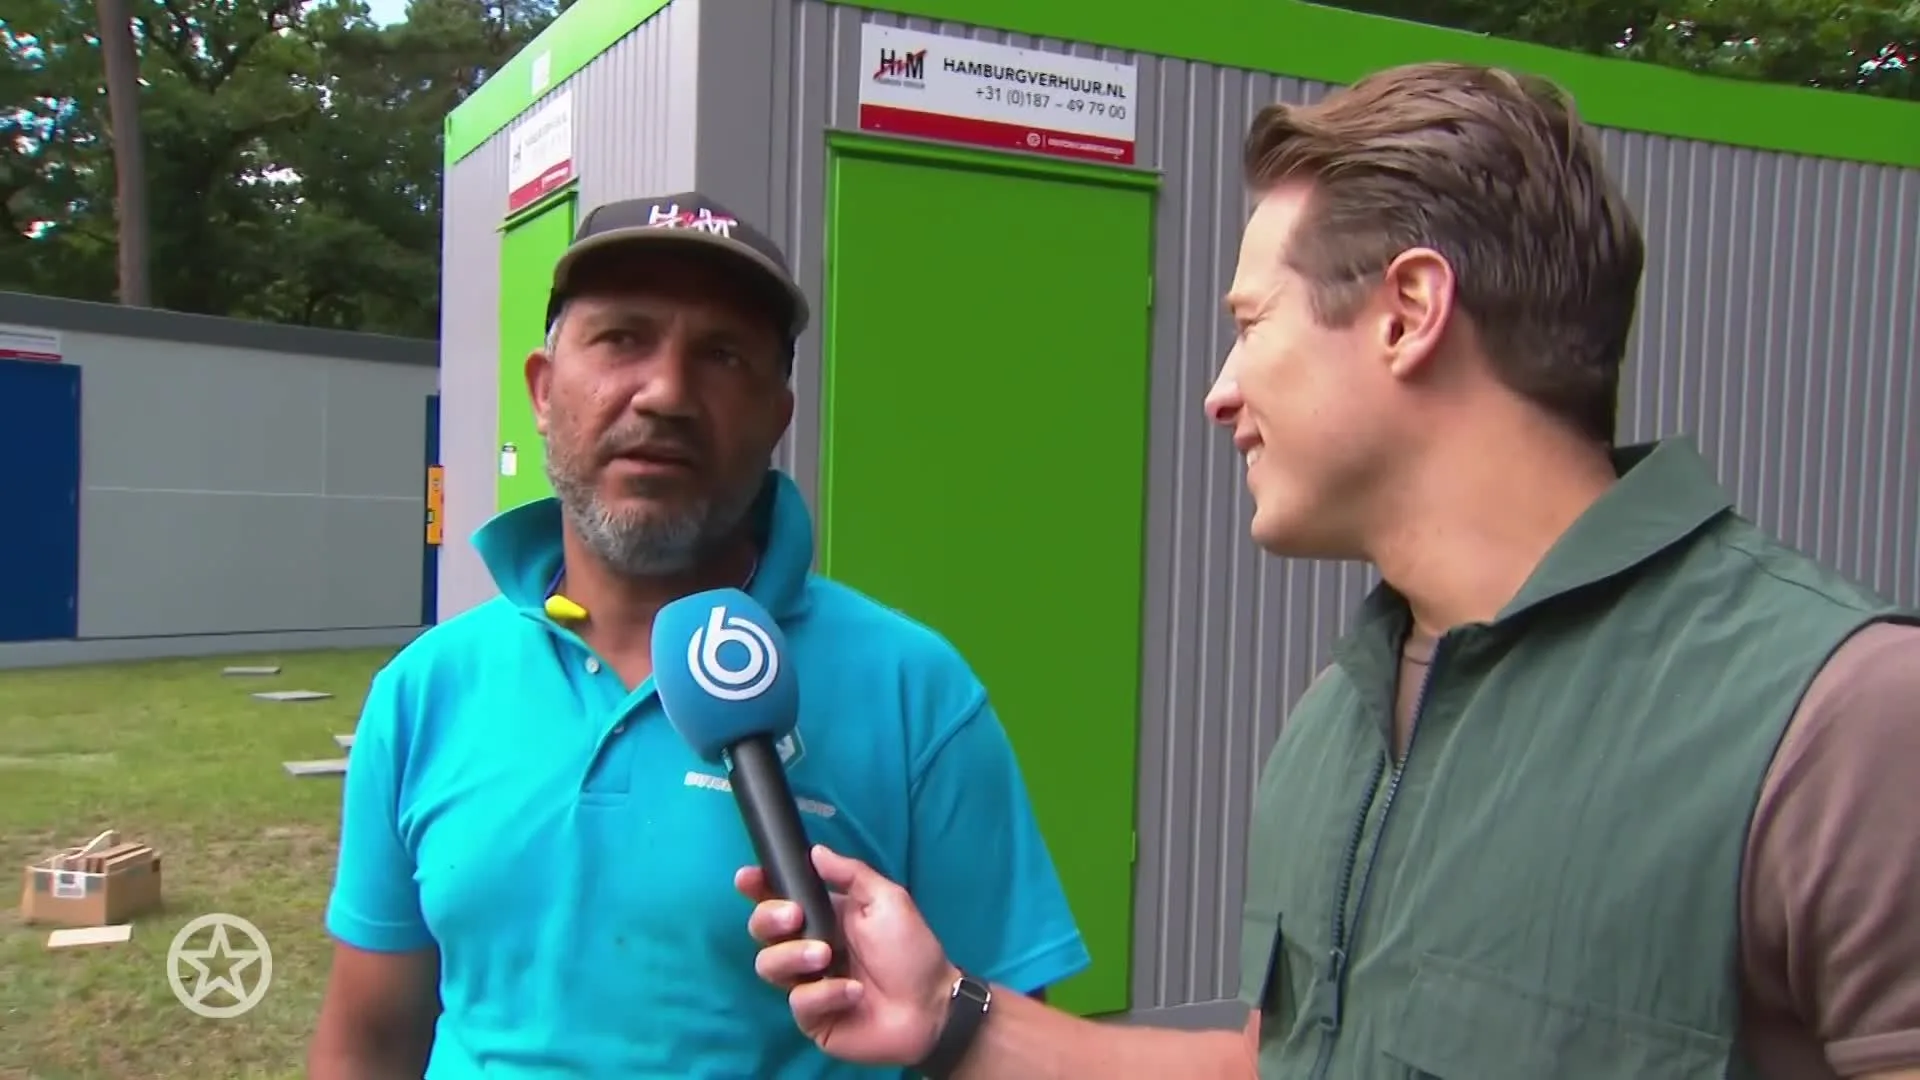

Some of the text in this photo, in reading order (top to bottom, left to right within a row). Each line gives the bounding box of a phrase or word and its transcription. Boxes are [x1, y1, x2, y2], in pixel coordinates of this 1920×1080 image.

[943, 57, 1126, 99] HAMBURGVERHUUR.NL
[976, 85, 1001, 102] +31
[1007, 89, 1050, 109] (0)187
[1066, 98, 1085, 113] 49
[1088, 102, 1105, 116] 79
[1108, 105, 1126, 120] 00
